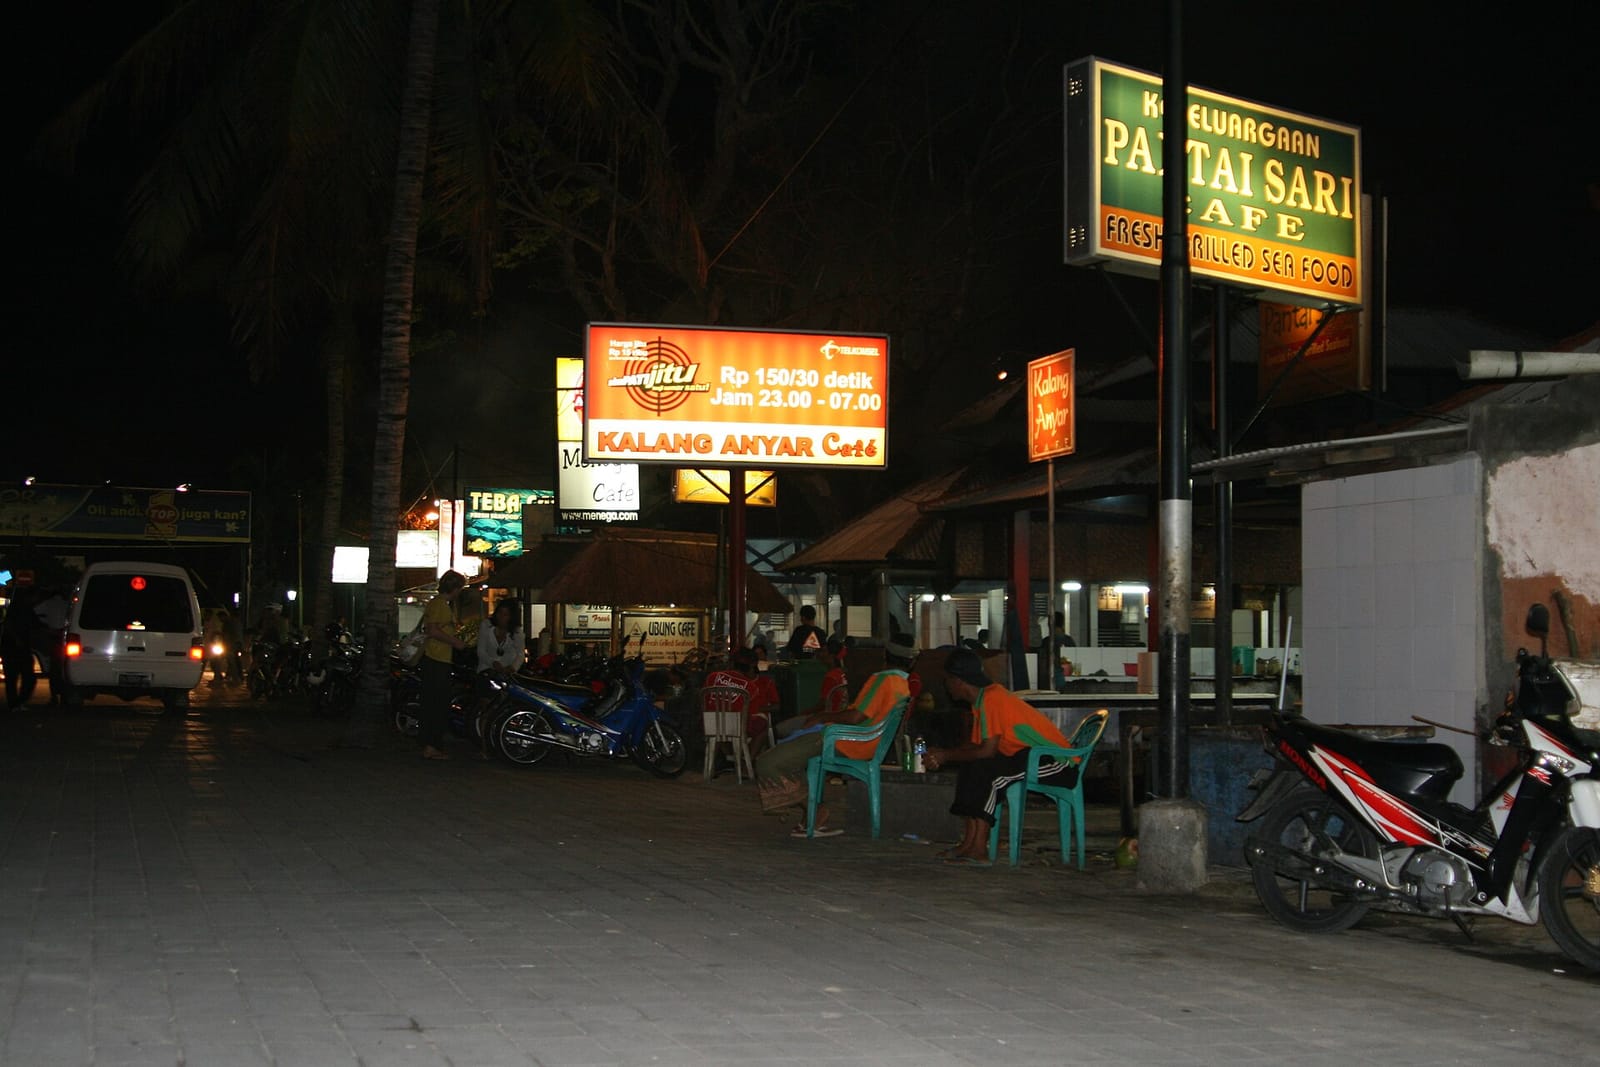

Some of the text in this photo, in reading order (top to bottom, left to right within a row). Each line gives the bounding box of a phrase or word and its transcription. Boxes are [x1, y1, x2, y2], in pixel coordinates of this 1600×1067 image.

[1104, 117, 1354, 220] PATAI SARI
[1186, 194, 1305, 242] AFE
[1189, 230, 1255, 270] RILLED
[1262, 247, 1295, 278] SEA
[1301, 255, 1354, 289] FOOD
[720, 367, 873, 390] Rp 150/30 detik
[1034, 366, 1069, 399] Kalang
[710, 387, 753, 407] Jam
[758, 390, 811, 409] 23.00
[829, 393, 881, 412] 07.00
[1034, 402, 1070, 440] Anyar
[597, 430, 878, 458] KALANG ANYAR Café
[469, 491, 520, 513] TEBA
[592, 482, 635, 503] Cafe
[648, 621, 696, 636] UBUNG CAFE
